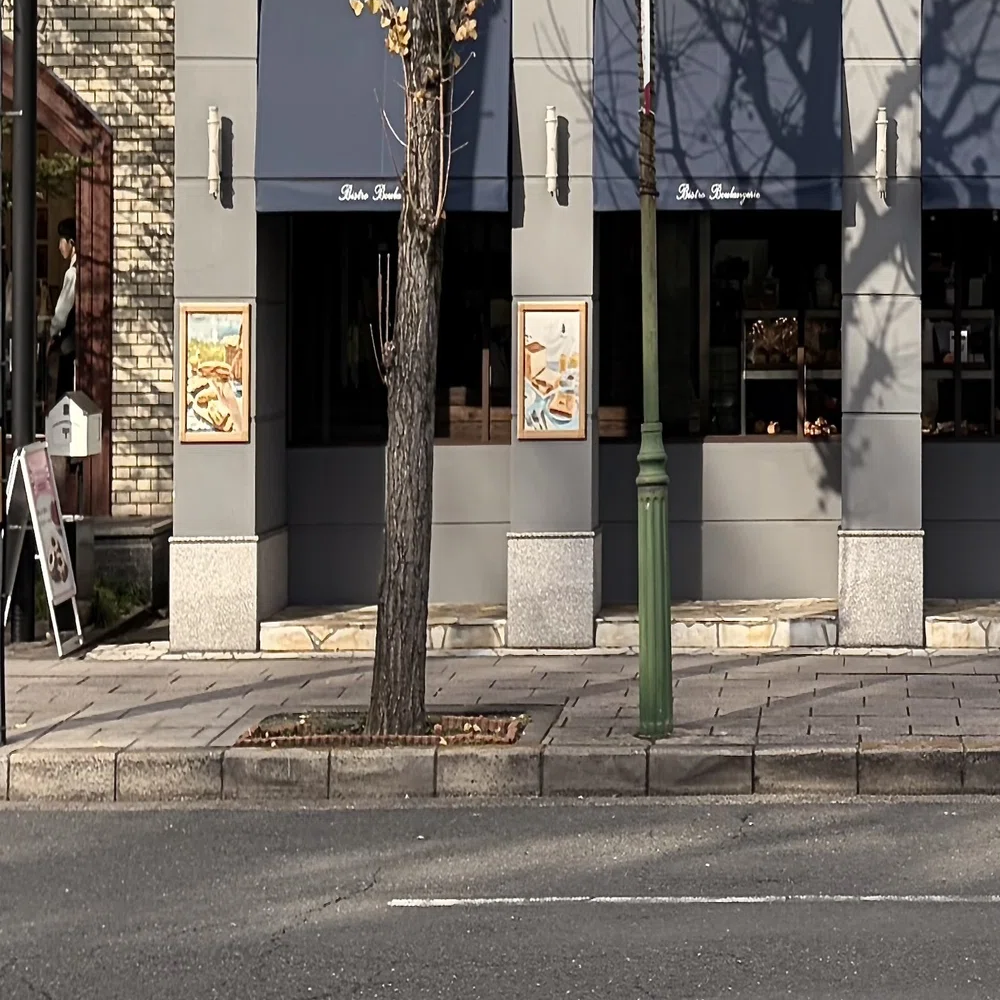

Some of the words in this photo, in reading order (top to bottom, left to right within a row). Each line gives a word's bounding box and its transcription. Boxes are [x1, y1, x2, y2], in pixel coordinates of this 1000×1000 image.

[338, 183, 369, 201] Bistro
[676, 182, 706, 201] Bistro
[709, 182, 761, 206] Boulangerie
